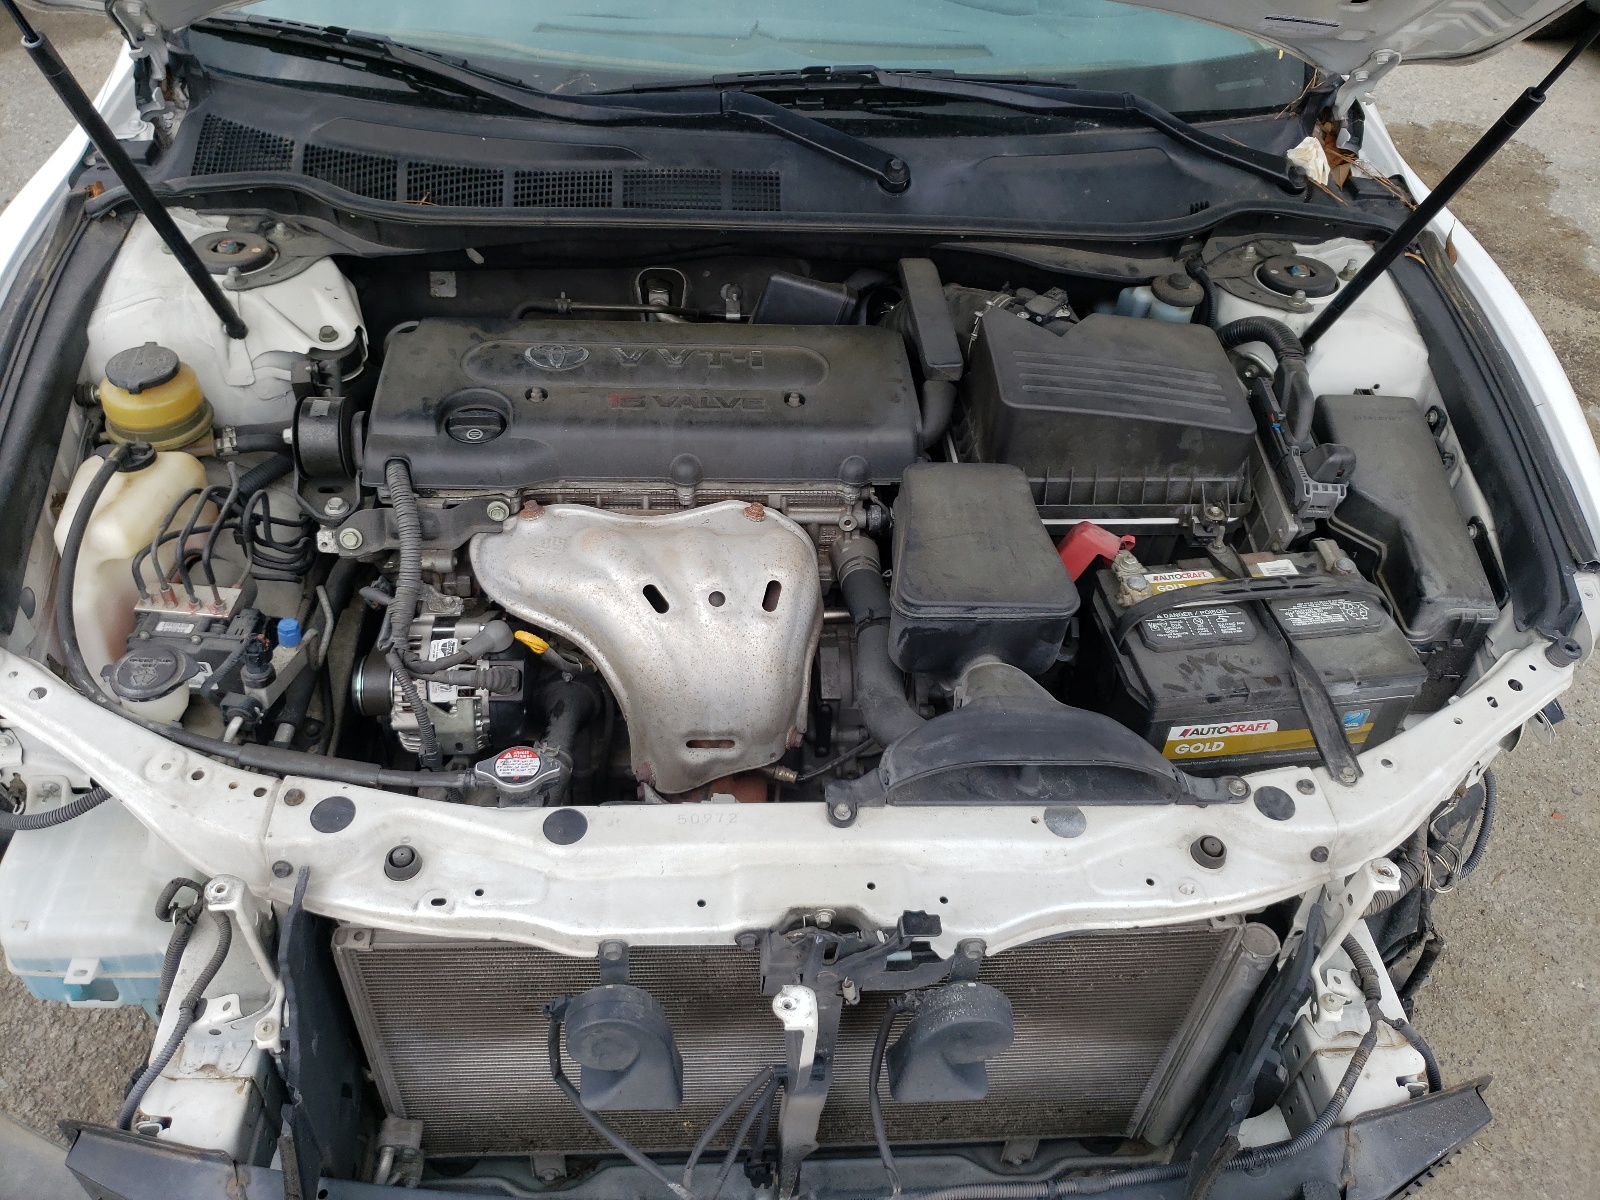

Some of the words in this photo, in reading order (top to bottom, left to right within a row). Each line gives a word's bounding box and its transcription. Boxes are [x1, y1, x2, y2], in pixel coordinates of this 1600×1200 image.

[652, 394, 766, 411] VALVE
[1159, 572, 1207, 581] AUTOCRAFT
[1189, 721, 1270, 737] AUTOCRAFT
[1174, 741, 1225, 755] GOLD
[678, 813, 738, 825] 50972
